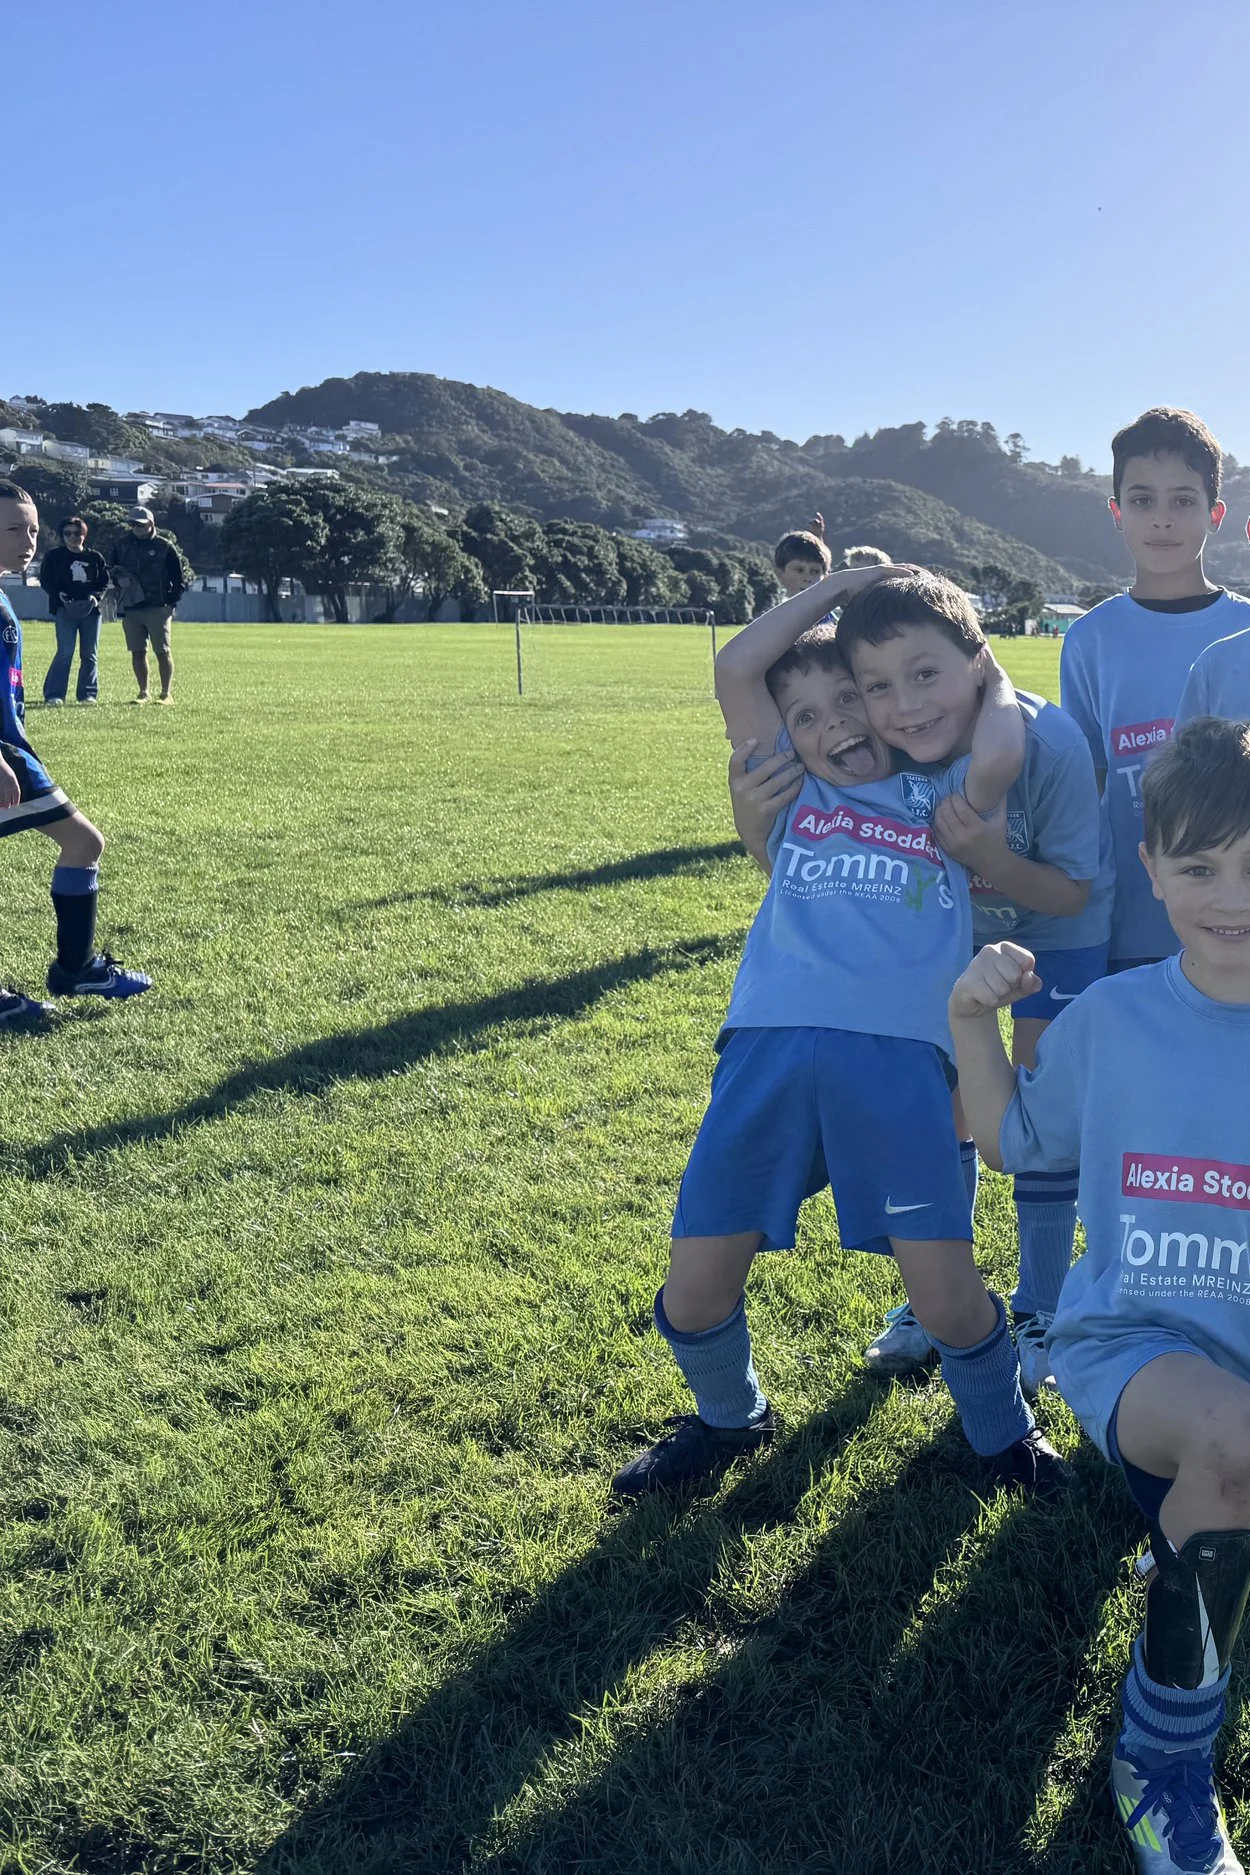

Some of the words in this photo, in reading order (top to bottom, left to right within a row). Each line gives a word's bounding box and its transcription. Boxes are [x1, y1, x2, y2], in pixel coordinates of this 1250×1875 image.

[1118, 726, 1166, 750] Alexia
[859, 822, 942, 861] Stoddat
[782, 879, 809, 893] Real
[811, 880, 847, 892] Estate
[851, 882, 902, 896] MREINZ
[1126, 1163, 1194, 1192] Alexia
[1140, 1273, 1187, 1286] Estate
[1148, 1289, 1177, 1297] under
[1179, 1288, 1194, 1298] the
[1197, 1289, 1224, 1300] REAA
[1227, 1293, 1250, 1306] 2008
